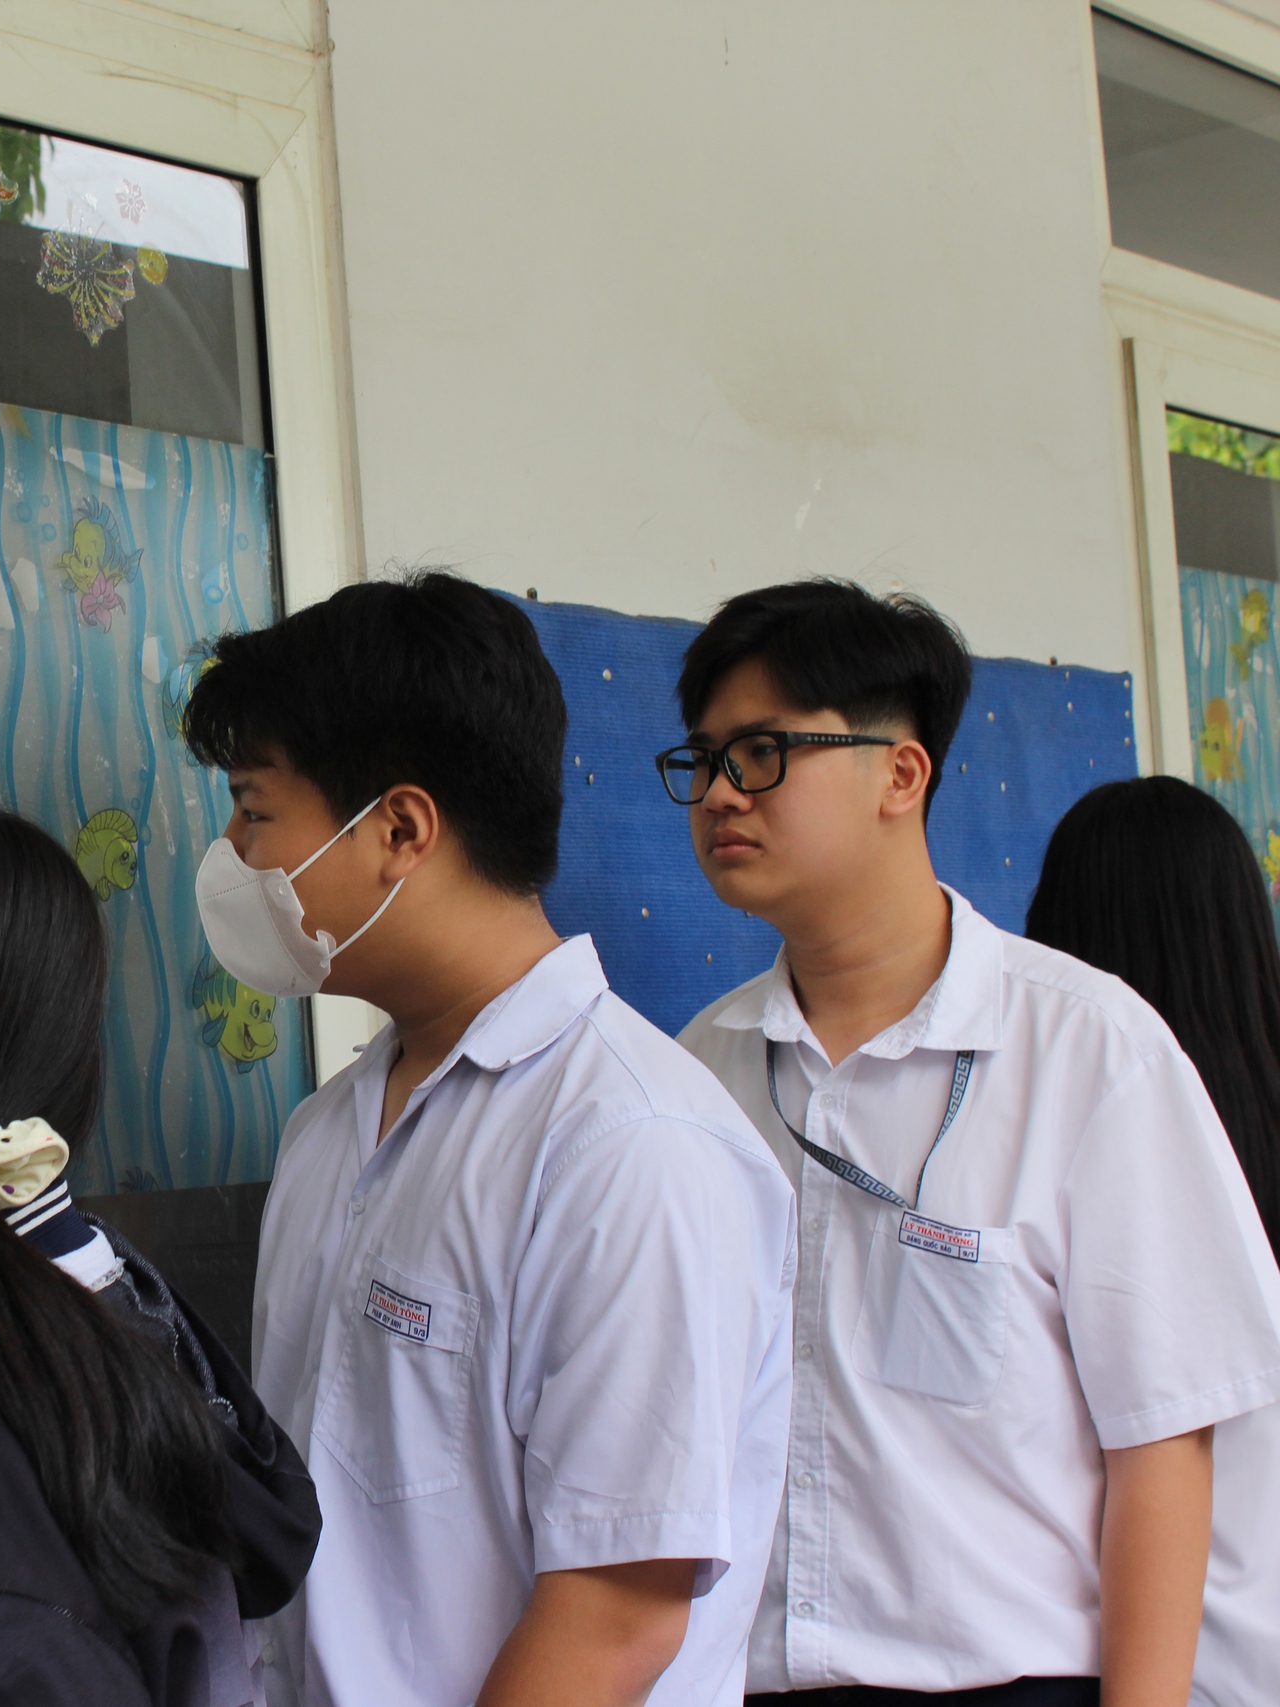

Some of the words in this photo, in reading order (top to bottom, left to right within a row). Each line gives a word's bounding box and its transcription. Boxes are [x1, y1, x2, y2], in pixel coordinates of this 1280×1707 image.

[904, 1222, 915, 1230] LÝ
[917, 1225, 945, 1240] THÁNH
[948, 1235, 974, 1246] TÔNG
[400, 1308, 424, 1322] TÔNG
[391, 1319, 401, 1329] ANH
[414, 1327, 425, 1337] 9/3
